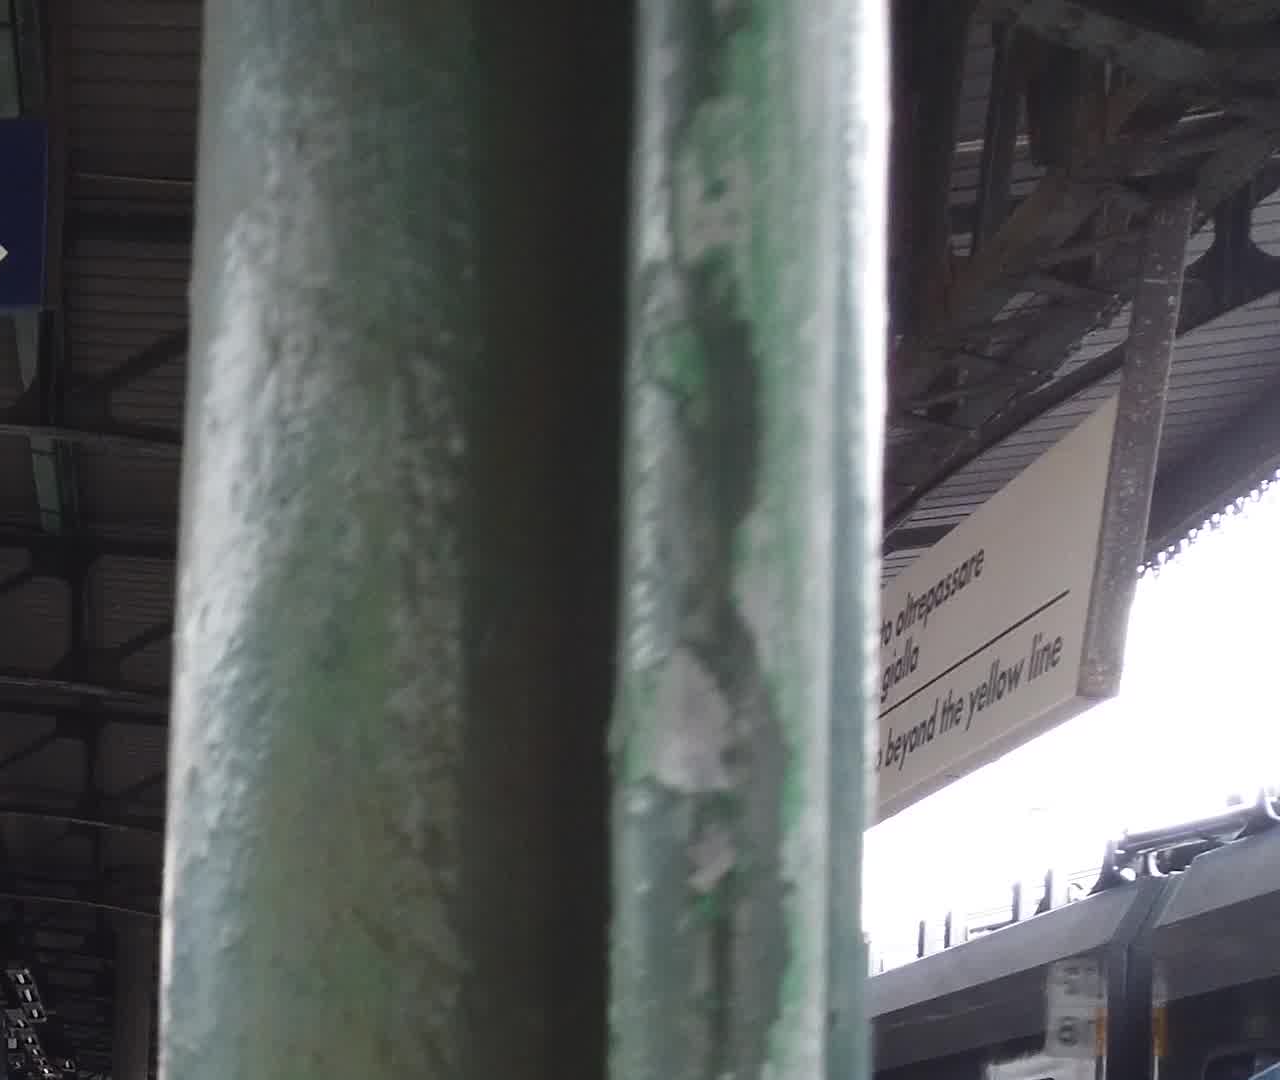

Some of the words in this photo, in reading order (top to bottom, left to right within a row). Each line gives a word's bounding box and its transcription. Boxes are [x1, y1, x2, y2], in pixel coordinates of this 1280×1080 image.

[896, 549, 985, 637] oltrepassare
[881, 636, 920, 704] gialla
[885, 697, 939, 771] beyond
[939, 688, 964, 734] the
[965, 657, 1025, 731] yellow
[1027, 632, 1063, 683] line
